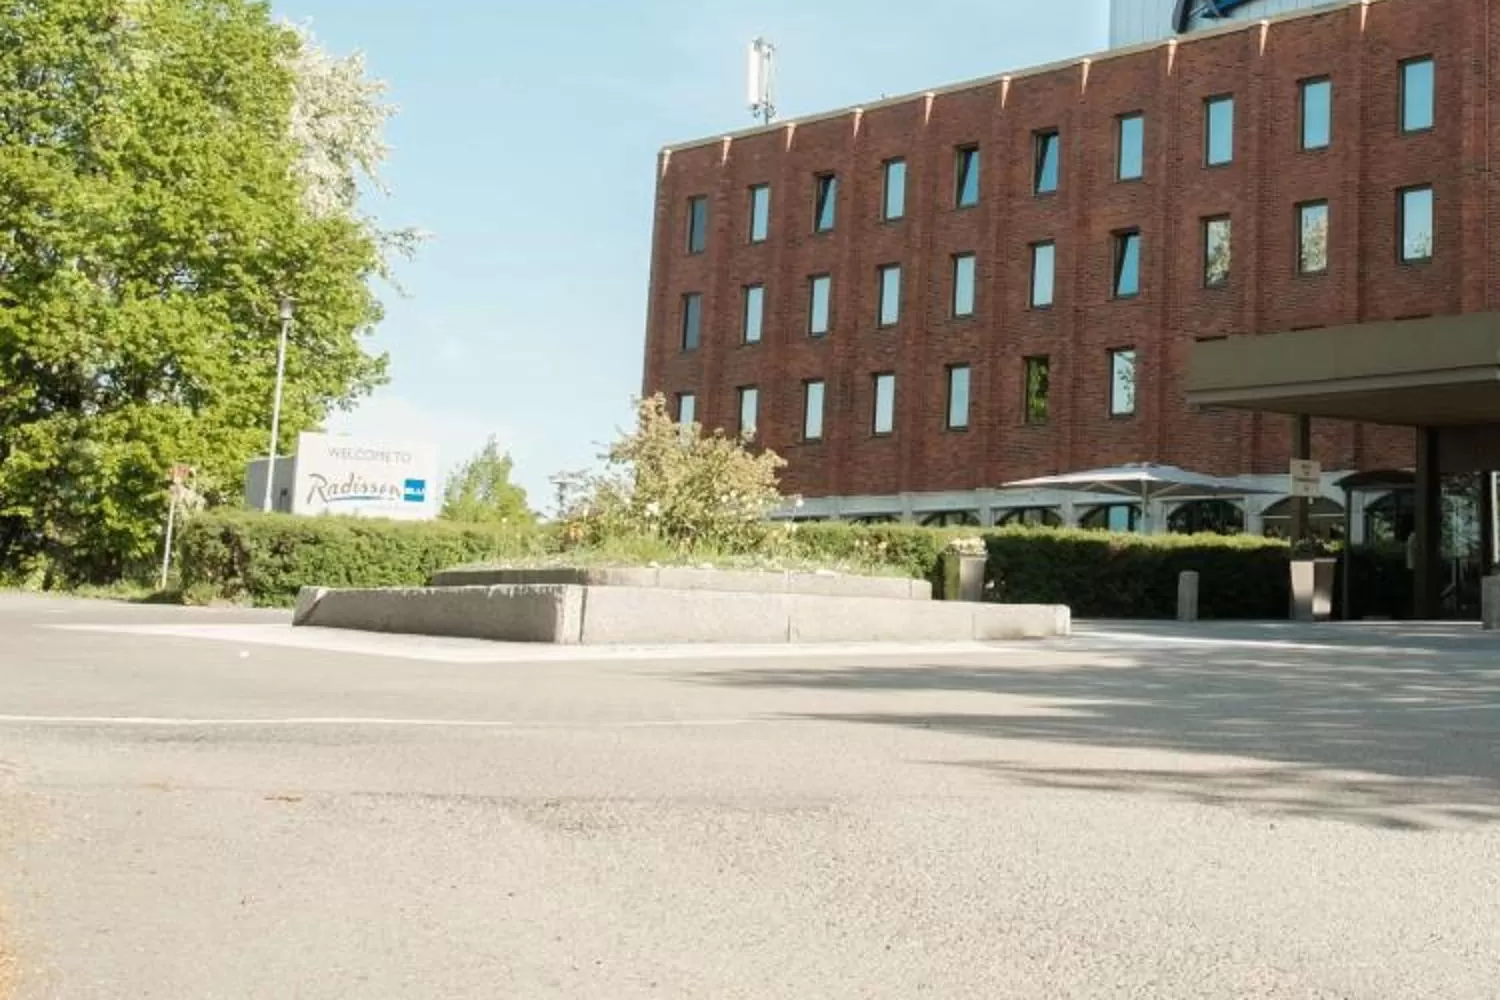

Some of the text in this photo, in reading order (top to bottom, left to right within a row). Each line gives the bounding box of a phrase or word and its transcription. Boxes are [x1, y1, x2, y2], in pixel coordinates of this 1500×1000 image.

[327, 447, 412, 465] WELCOME TO
[306, 471, 401, 504] Radisson
